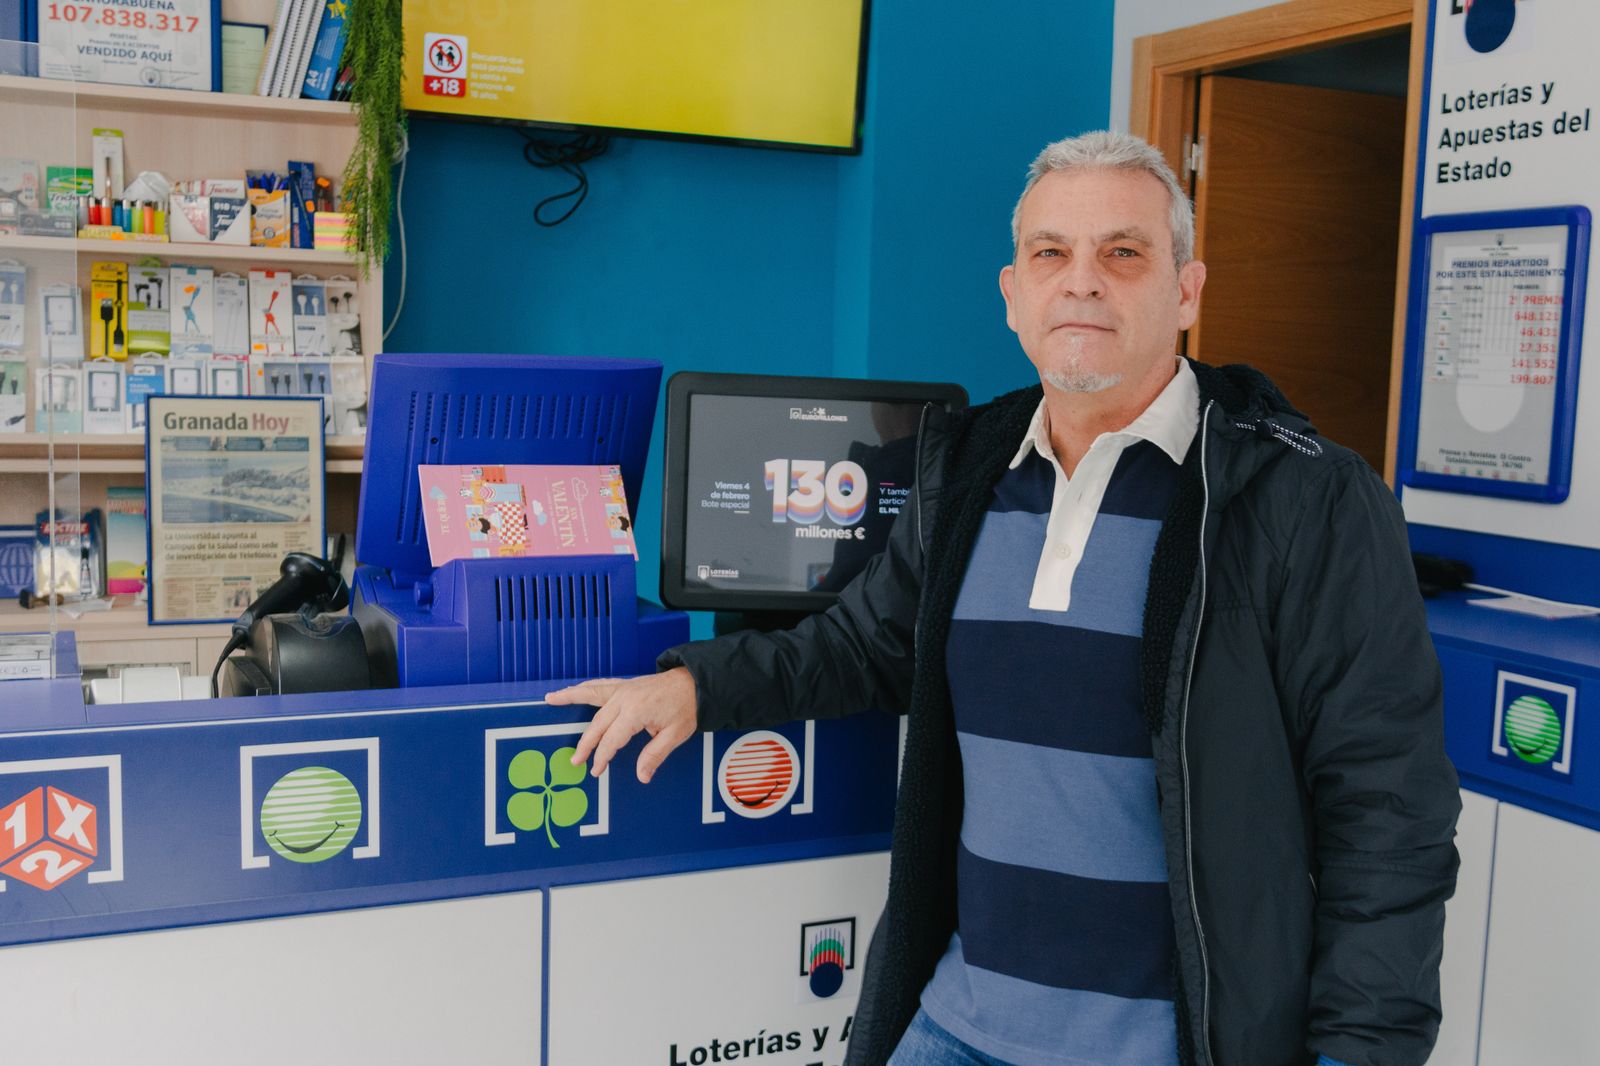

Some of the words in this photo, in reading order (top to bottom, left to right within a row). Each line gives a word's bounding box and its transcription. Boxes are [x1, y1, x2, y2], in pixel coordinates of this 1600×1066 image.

[76, 0, 175, 11] ORABUENA
[48, 4, 199, 33] 107.838.317
[77, 45, 137, 59] VENDIDO
[140, 49, 172, 63] AQUÍ
[429, 79, 460, 95] +18
[1441, 83, 1533, 114] Loterías
[1541, 82, 1555, 104] y
[1438, 120, 1543, 152] Apuestas
[1553, 108, 1591, 135] del
[1436, 156, 1513, 184] Estado
[1452, 259, 1490, 269] PREMIOS
[1491, 258, 1549, 268] REPARTIDOS
[1436, 271, 1455, 279] POR
[1456, 270, 1478, 279] ESTE
[1480, 268, 1565, 278] ESTABLECIMIENTO
[163, 412, 248, 430] Granada
[252, 413, 290, 435] Hoy
[715, 481, 743, 490] Viernes
[744, 482, 750, 490] 4
[764, 458, 868, 526] 130
[710, 490, 721, 499] de
[722, 491, 750, 500] febrero
[701, 500, 719, 509] Bote
[720, 500, 750, 511] especial
[165, 532, 173, 540] La
[175, 532, 221, 540] Universidad
[222, 532, 249, 542] apunta
[795, 526, 852, 539] millones
[854, 527, 866, 540] €
[165, 542, 196, 551] Campus
[197, 542, 206, 550] de
[217, 542, 239, 550] Salud
[165, 553, 175, 561] de
[176, 551, 227, 562] investigación
[228, 552, 238, 560] de
[239, 551, 278, 560] Telefónica
[670, 1029, 802, 1066] Loterías
[812, 1026, 829, 1053] y
